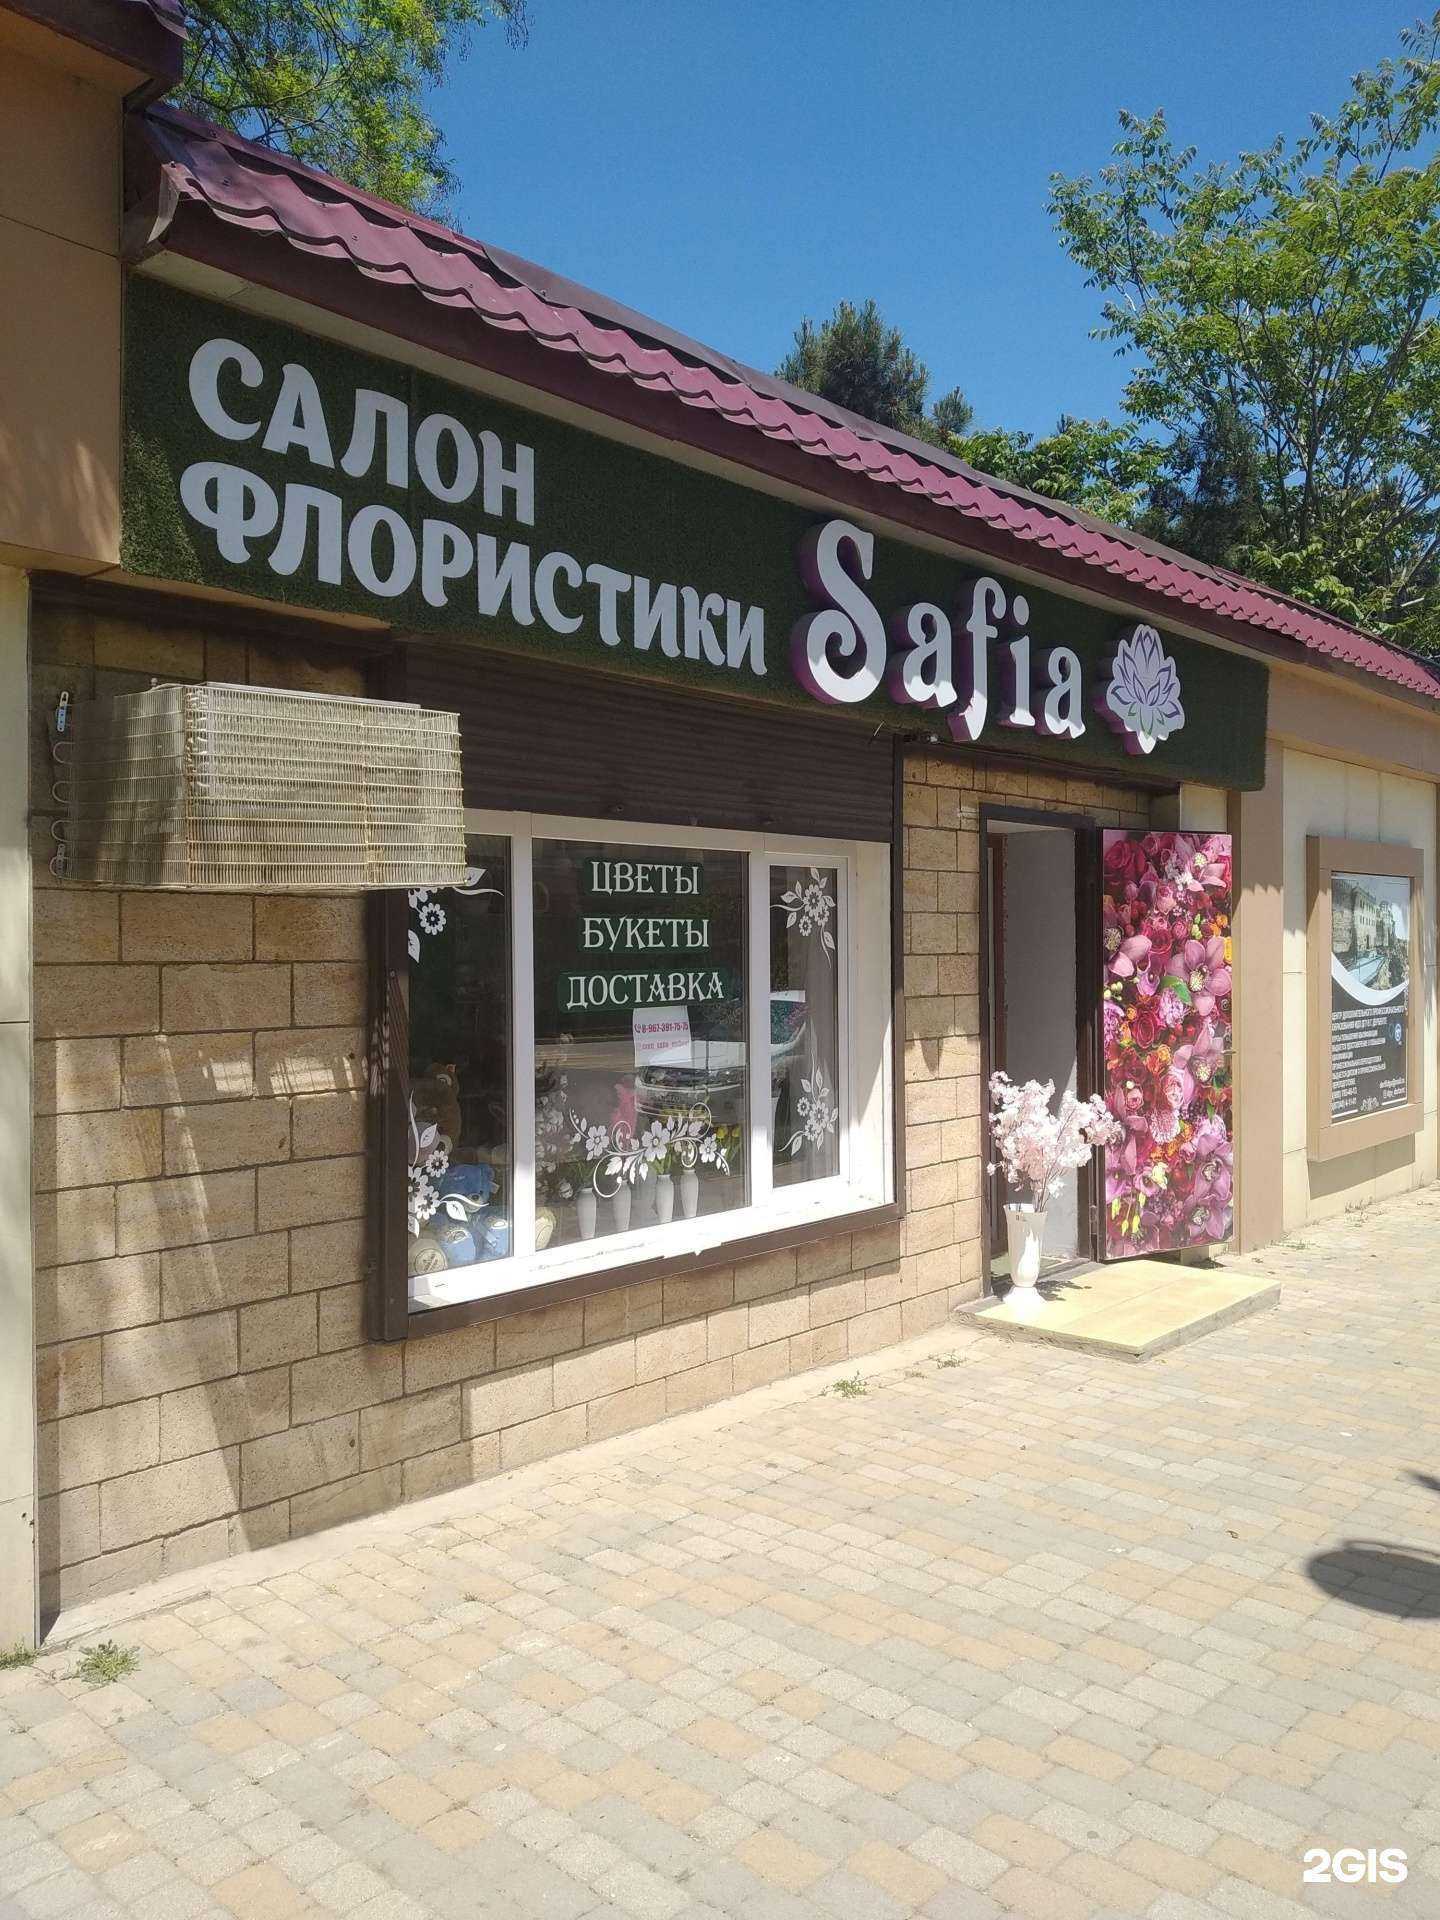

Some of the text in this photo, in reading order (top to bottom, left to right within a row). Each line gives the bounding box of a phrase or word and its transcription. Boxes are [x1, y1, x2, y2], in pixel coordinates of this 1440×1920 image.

[189, 338, 535, 526] САЛОН
[180, 461, 768, 675] ФЛОРИСТИКИ
[805, 519, 1085, 741] Safia
[582, 915, 709, 951] БУКЕТЫ
[591, 861, 699, 896] ЦВЕТЫ
[566, 972, 724, 1010] ДОСТАВКА
